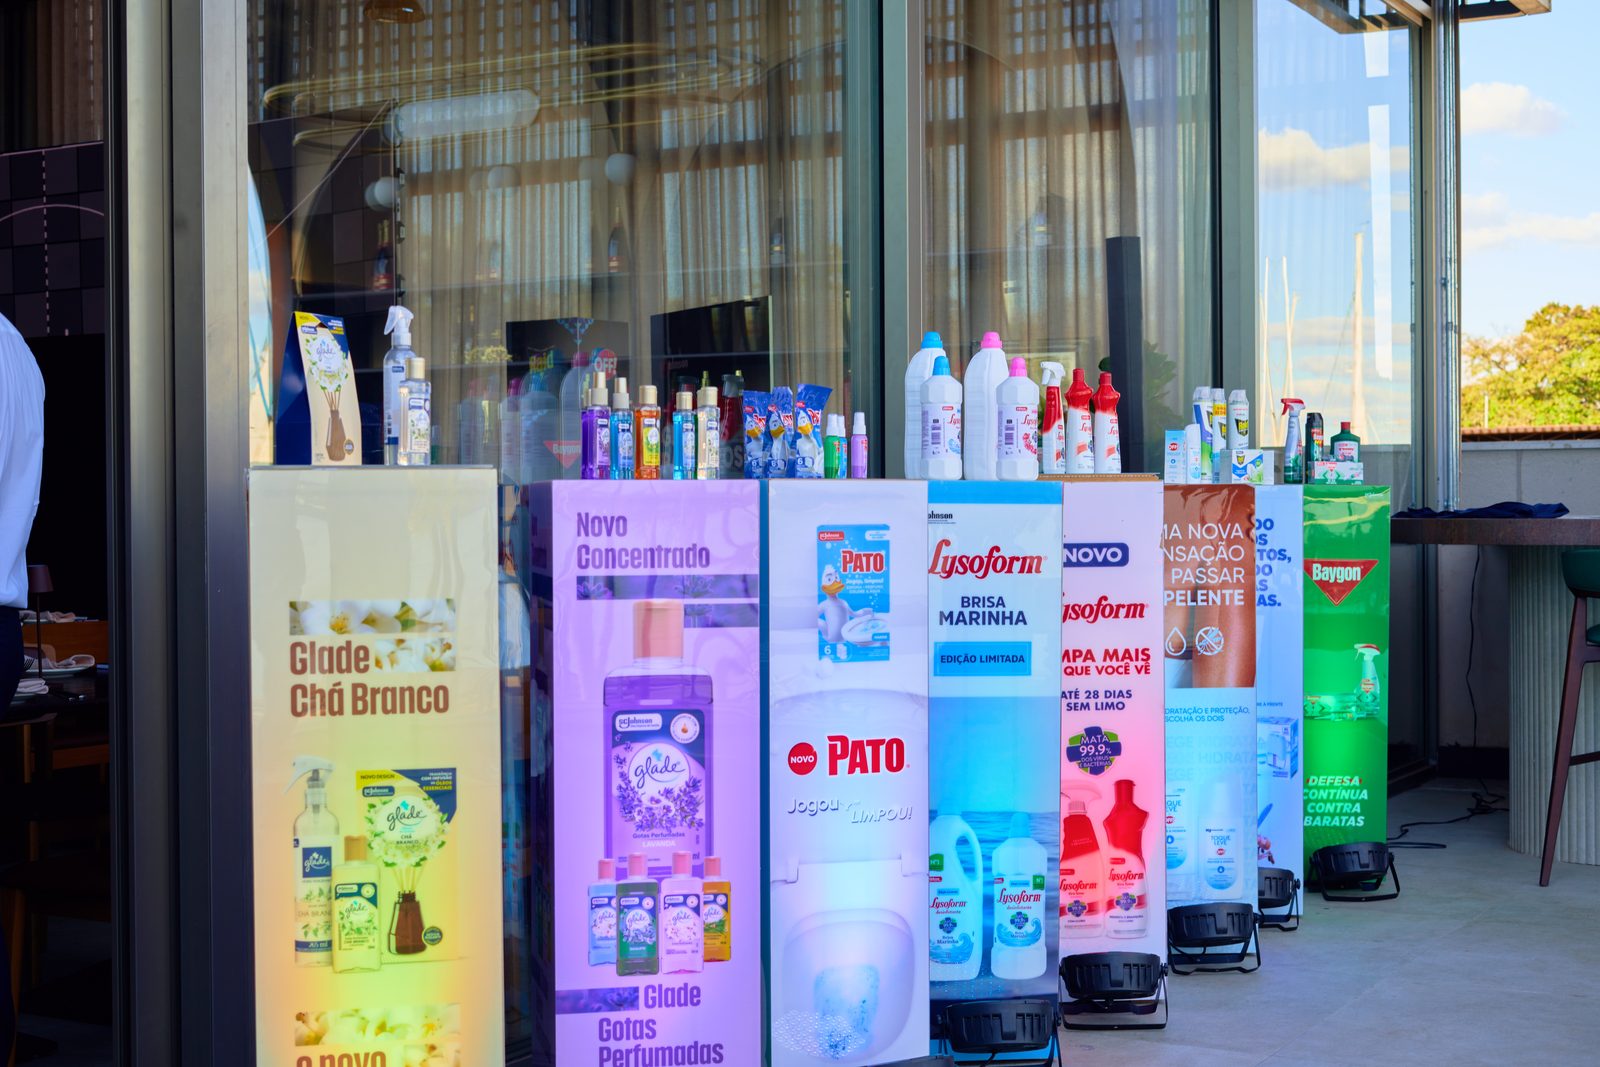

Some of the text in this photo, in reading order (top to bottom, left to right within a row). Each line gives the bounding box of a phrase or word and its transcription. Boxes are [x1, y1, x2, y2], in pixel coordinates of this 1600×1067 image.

[576, 511, 628, 538] Novo
[1188, 522, 1244, 540] NOVA
[577, 543, 711, 570] Concentrado
[841, 549, 884, 573] PATO
[928, 538, 1043, 580] Lysoform
[1064, 547, 1123, 563] NOVO
[1171, 567, 1245, 584] PASSAR
[1312, 563, 1361, 583] Baygon
[961, 596, 1006, 609] BRISA
[1164, 590, 1245, 607] PELENTE
[939, 610, 1028, 626] MARINHA
[289, 640, 370, 675] Glade
[824, 645, 831, 655] 6
[1102, 648, 1151, 663] MAIS
[940, 654, 1025, 666] EDIÇÃO LIMITADA
[1064, 661, 1151, 676] QUE VOCÊ VÊ
[290, 682, 449, 717] Chá Branco
[1061, 688, 1132, 700] ATÉ 28 DIAS
[1066, 702, 1126, 711] SEM LIMO
[1081, 735, 1109, 745] MATA
[790, 755, 815, 764] NOVO
[827, 735, 905, 776] PATO
[634, 755, 686, 789] glade
[1308, 776, 1360, 787] DEFESA
[787, 799, 839, 816] Jogou
[851, 806, 913, 823] LIMPOU!
[1307, 802, 1361, 813] CONTRA
[387, 805, 426, 831] glade
[1304, 816, 1365, 826] BARATAS
[304, 854, 328, 872] glade
[931, 897, 967, 909] Lysoform
[998, 888, 1041, 903] Lysoform
[643, 983, 701, 1008] Glade
[598, 1018, 657, 1042] Gotas
[599, 1041, 724, 1067] Perfumadas
